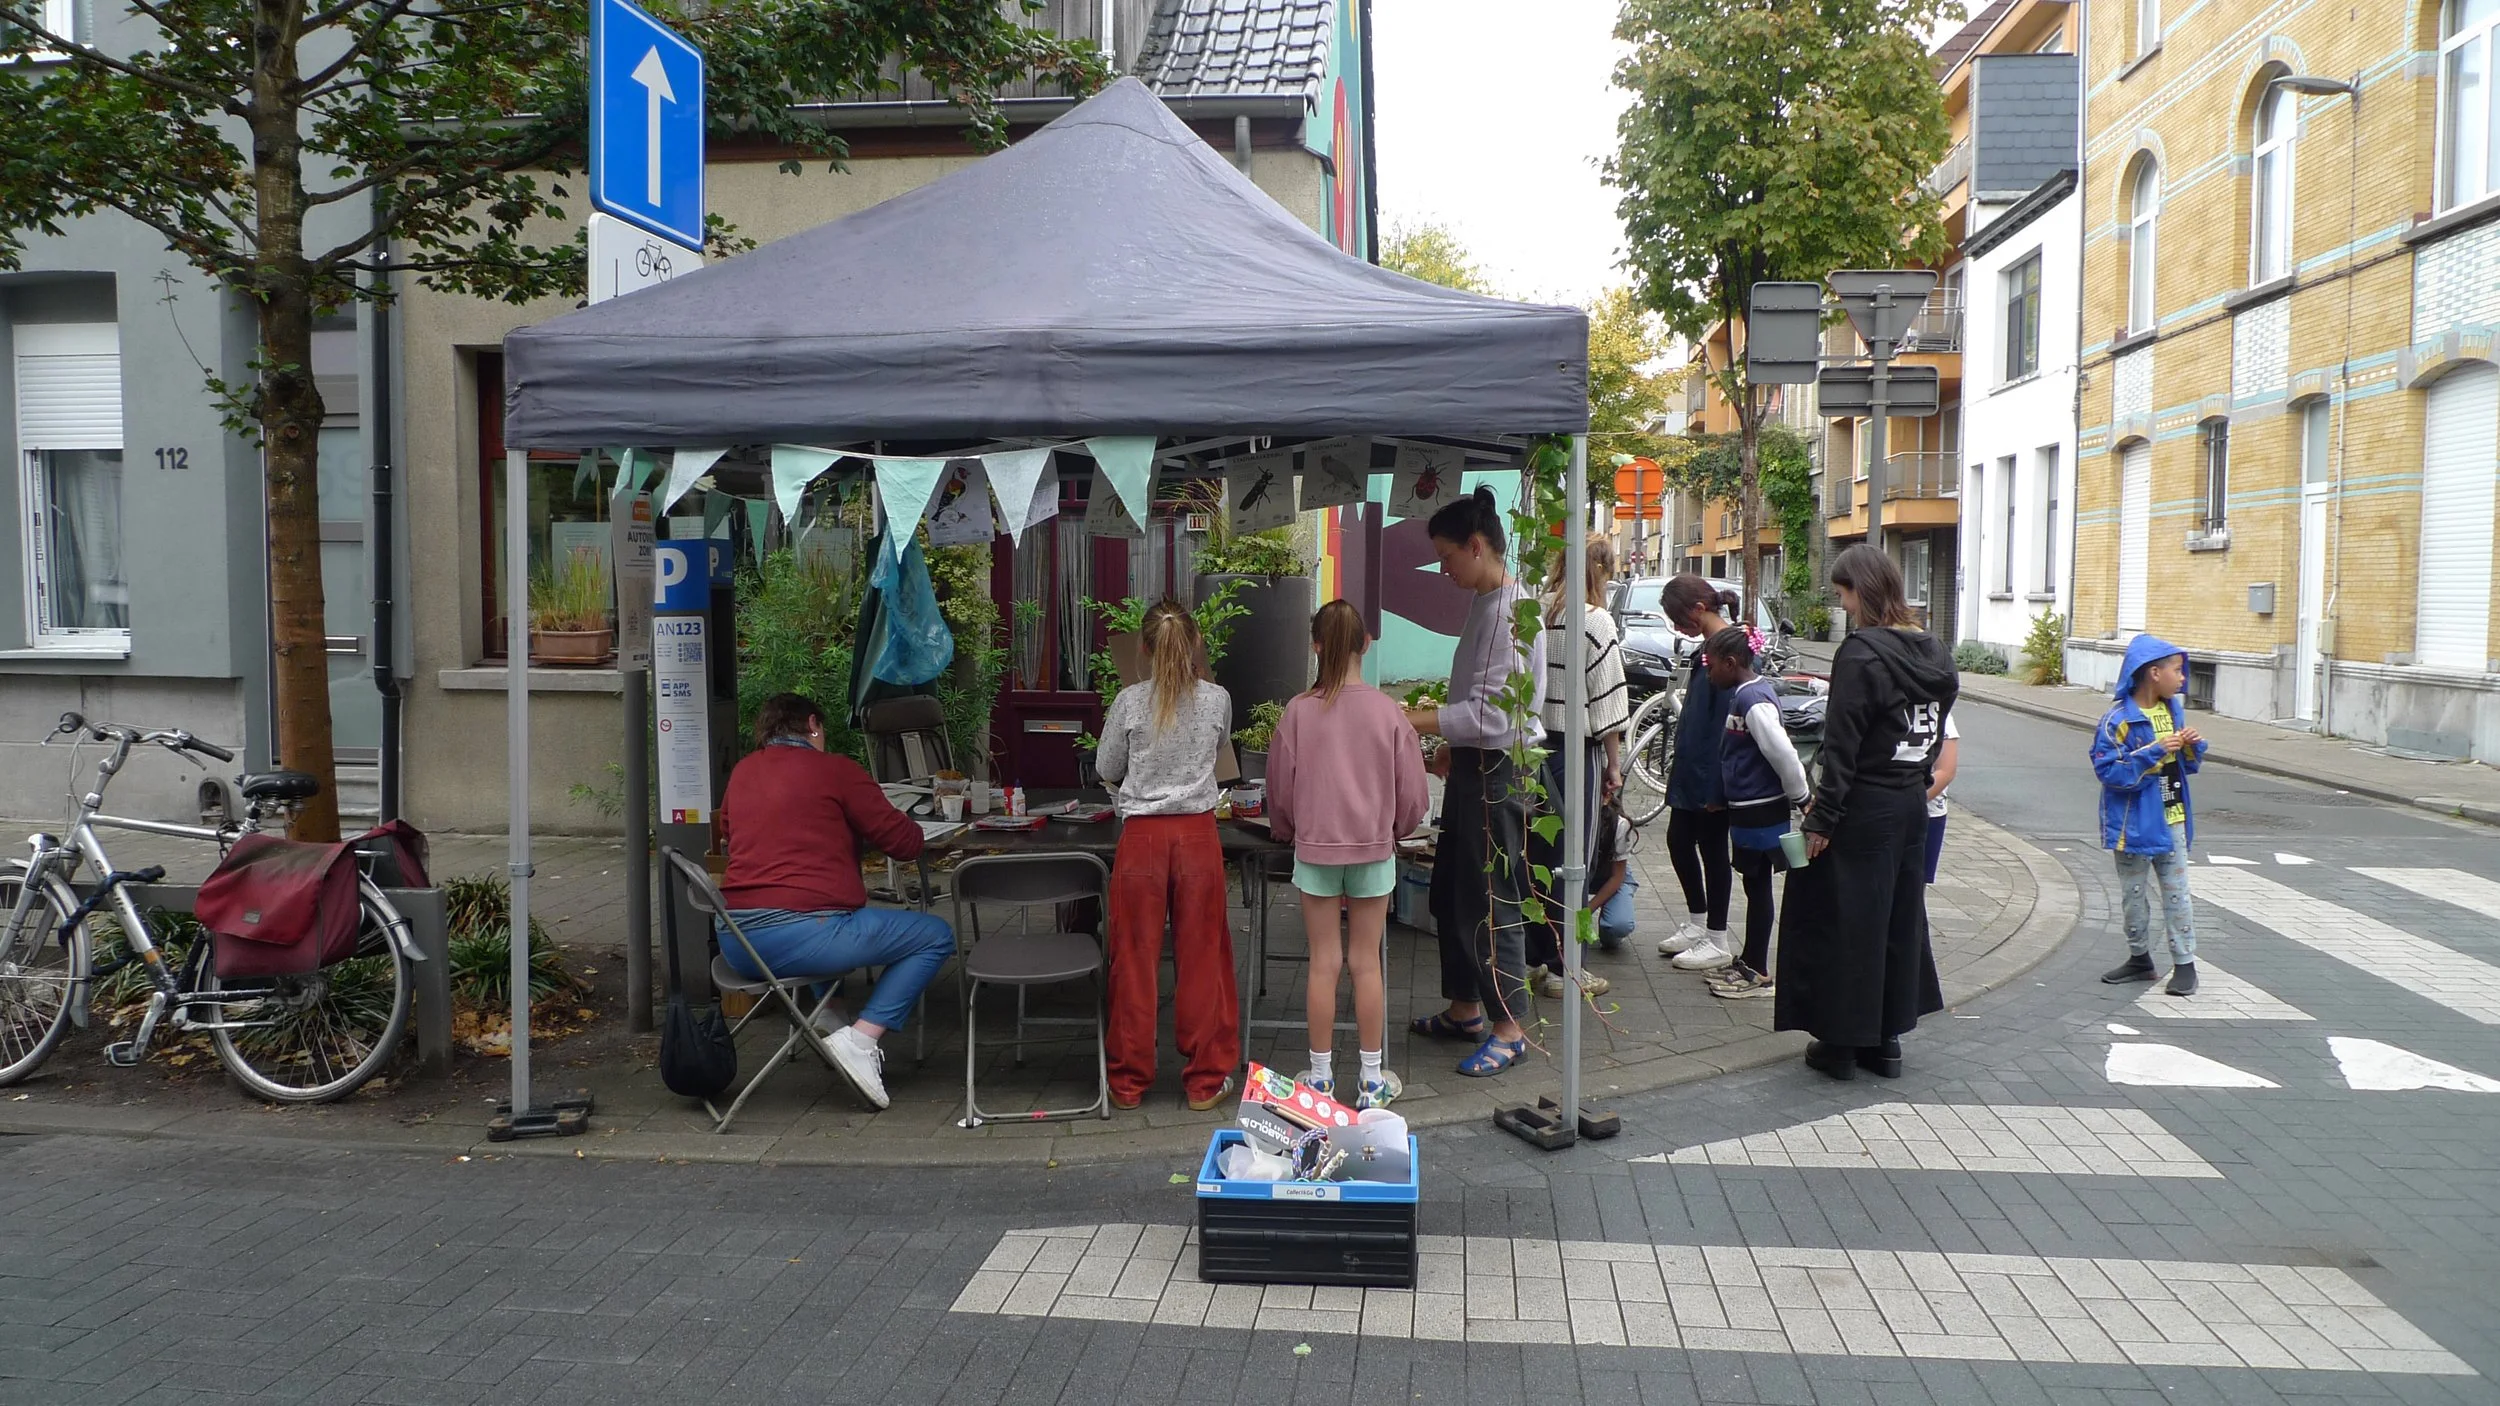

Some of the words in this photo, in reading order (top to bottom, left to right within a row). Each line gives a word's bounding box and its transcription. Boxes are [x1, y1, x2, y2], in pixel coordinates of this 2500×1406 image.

[155, 447, 188, 470] 112
[655, 548, 688, 604] P
[656, 622, 702, 636] AN123
[1904, 701, 1940, 733] ES
[675, 811, 683, 821] A
[1249, 1119, 1290, 1146] DIABOLO
